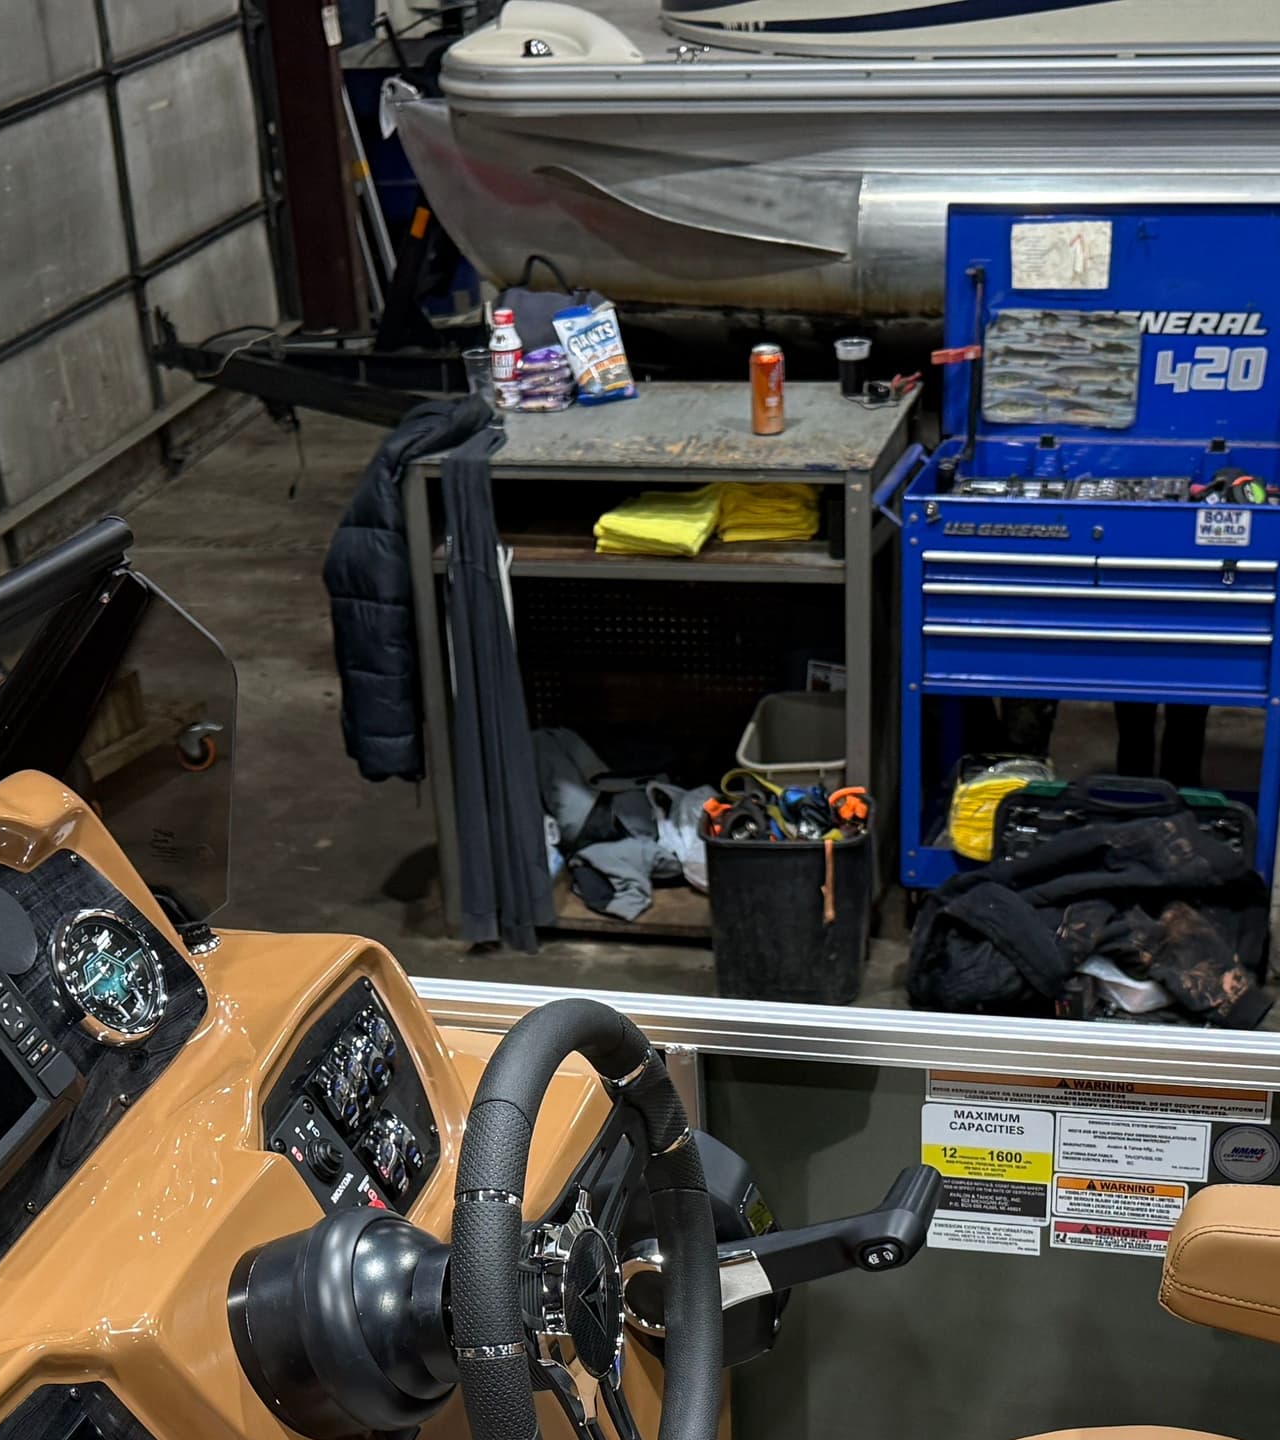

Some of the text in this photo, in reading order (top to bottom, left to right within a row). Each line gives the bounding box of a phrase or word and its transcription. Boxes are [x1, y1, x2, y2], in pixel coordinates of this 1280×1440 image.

[1106, 311, 1268, 336] NERAL
[1154, 346, 1268, 393] 420
[1204, 511, 1242, 524] BOAT
[1073, 1079, 1135, 1093] WARNING
[954, 1109, 1020, 1123] MAXIMUM
[949, 1121, 1025, 1136] CAPACITIES
[941, 1147, 1023, 1164] 12 1600
[330, 1172, 355, 1204] HONDA
[1099, 1181, 1156, 1194] WARNING
[1095, 1226, 1148, 1239] DANGER
